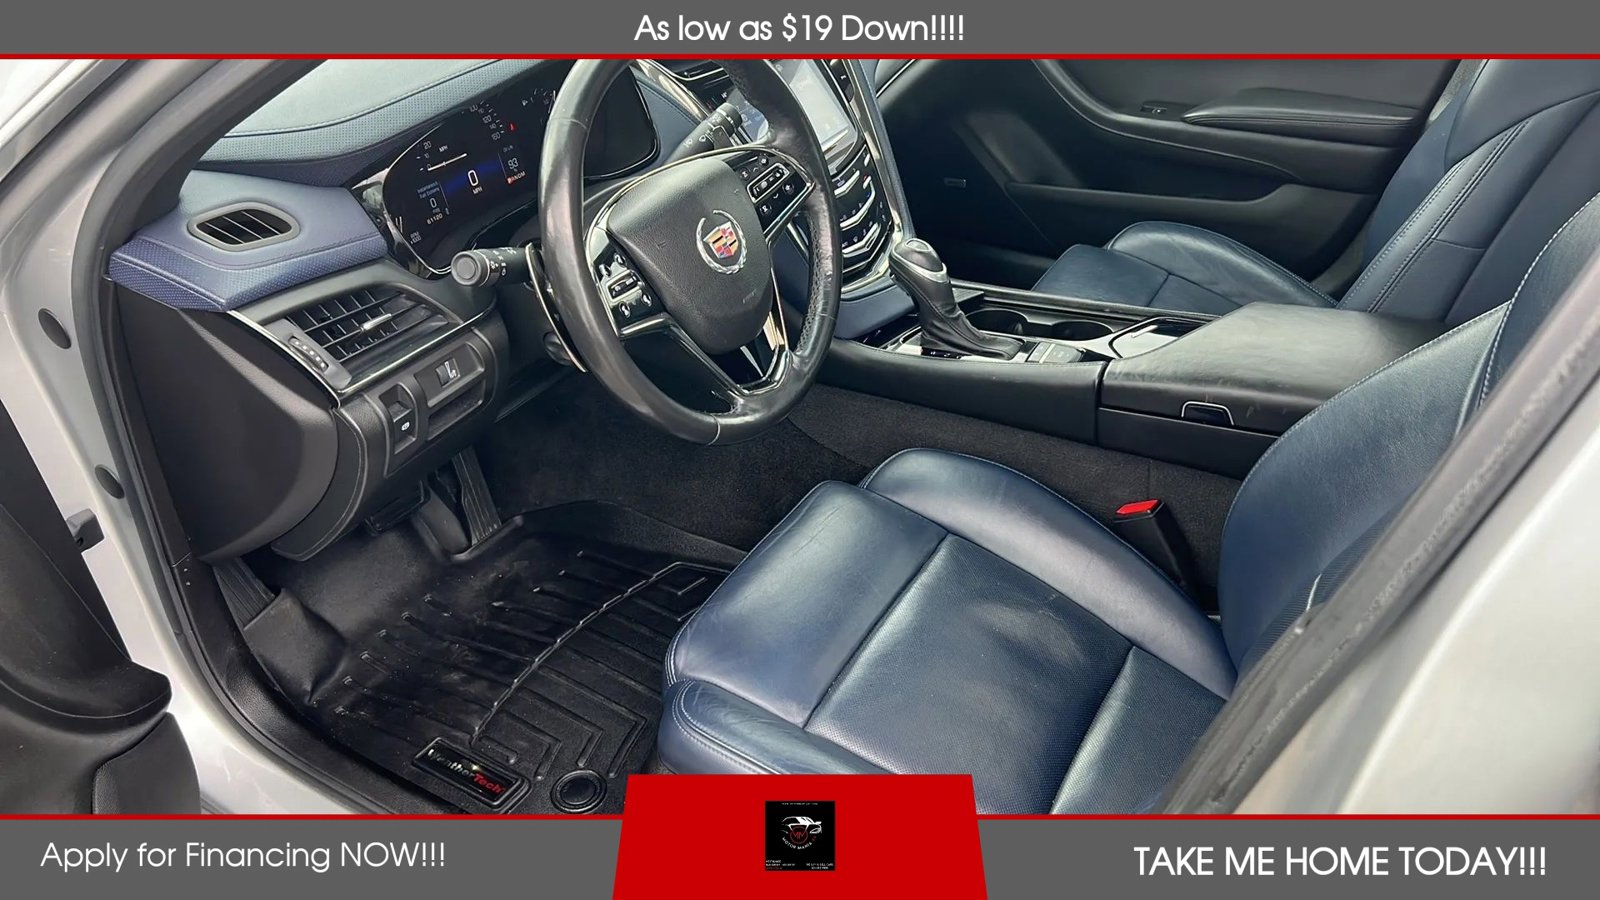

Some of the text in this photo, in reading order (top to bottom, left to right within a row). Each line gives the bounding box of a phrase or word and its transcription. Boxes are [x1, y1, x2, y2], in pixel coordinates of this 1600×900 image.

[483, 115, 492, 124] 120
[424, 141, 432, 149] 20
[508, 158, 518, 170] 93
[468, 170, 479, 187] 0
[472, 186, 482, 194] MPH
[430, 198, 437, 208] 0
